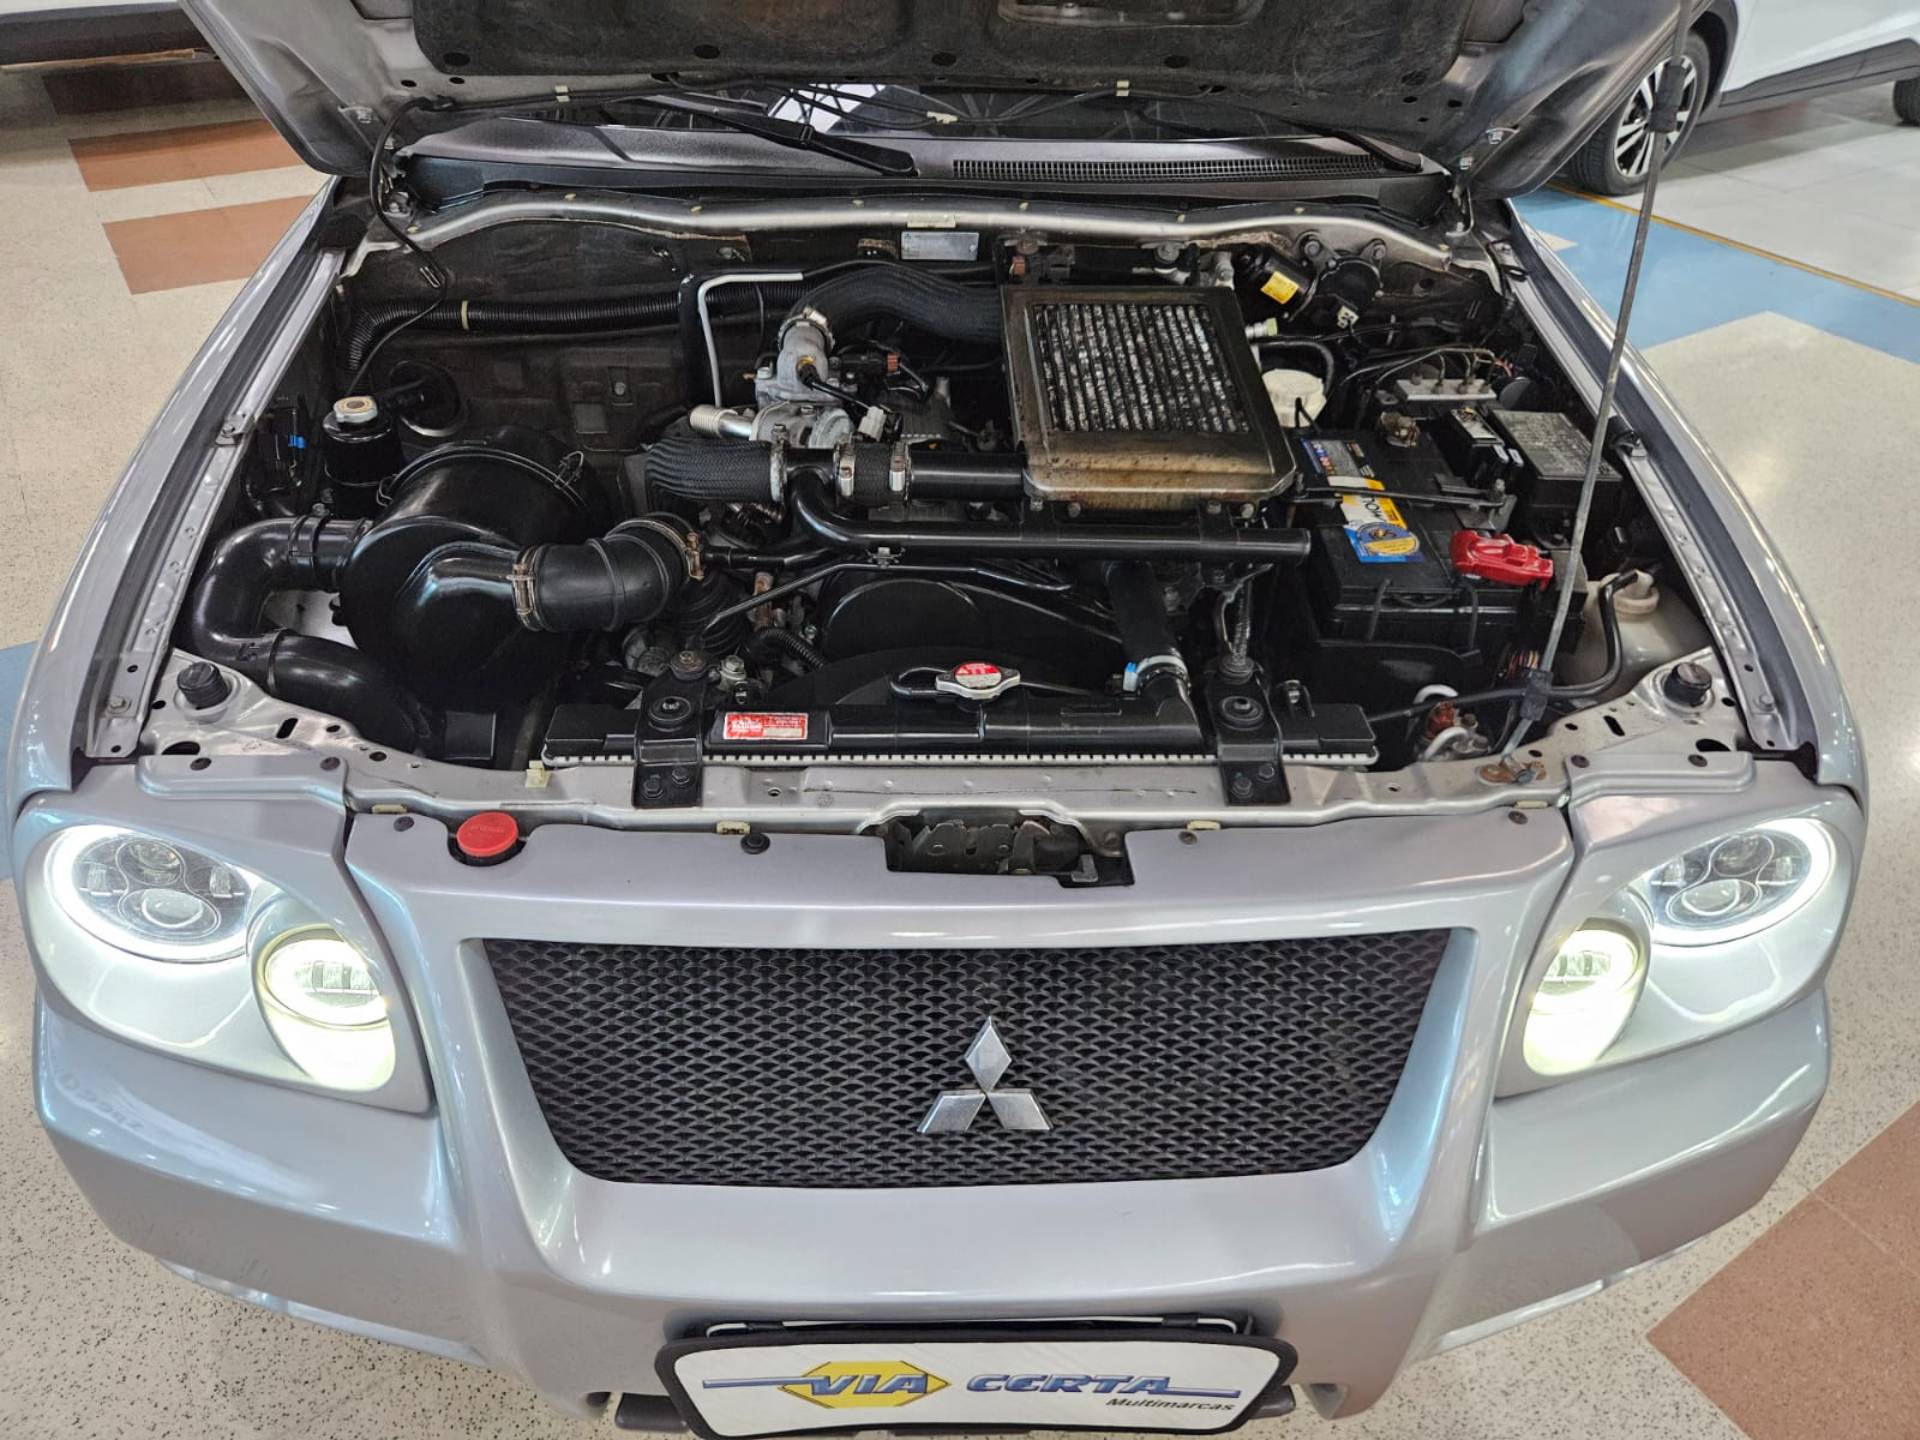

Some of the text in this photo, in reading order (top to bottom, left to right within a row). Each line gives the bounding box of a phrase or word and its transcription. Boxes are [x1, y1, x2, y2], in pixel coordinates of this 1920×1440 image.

[811, 1374, 1171, 1396] VIA CERTA
[1105, 1398, 1236, 1411] Multimarcas
